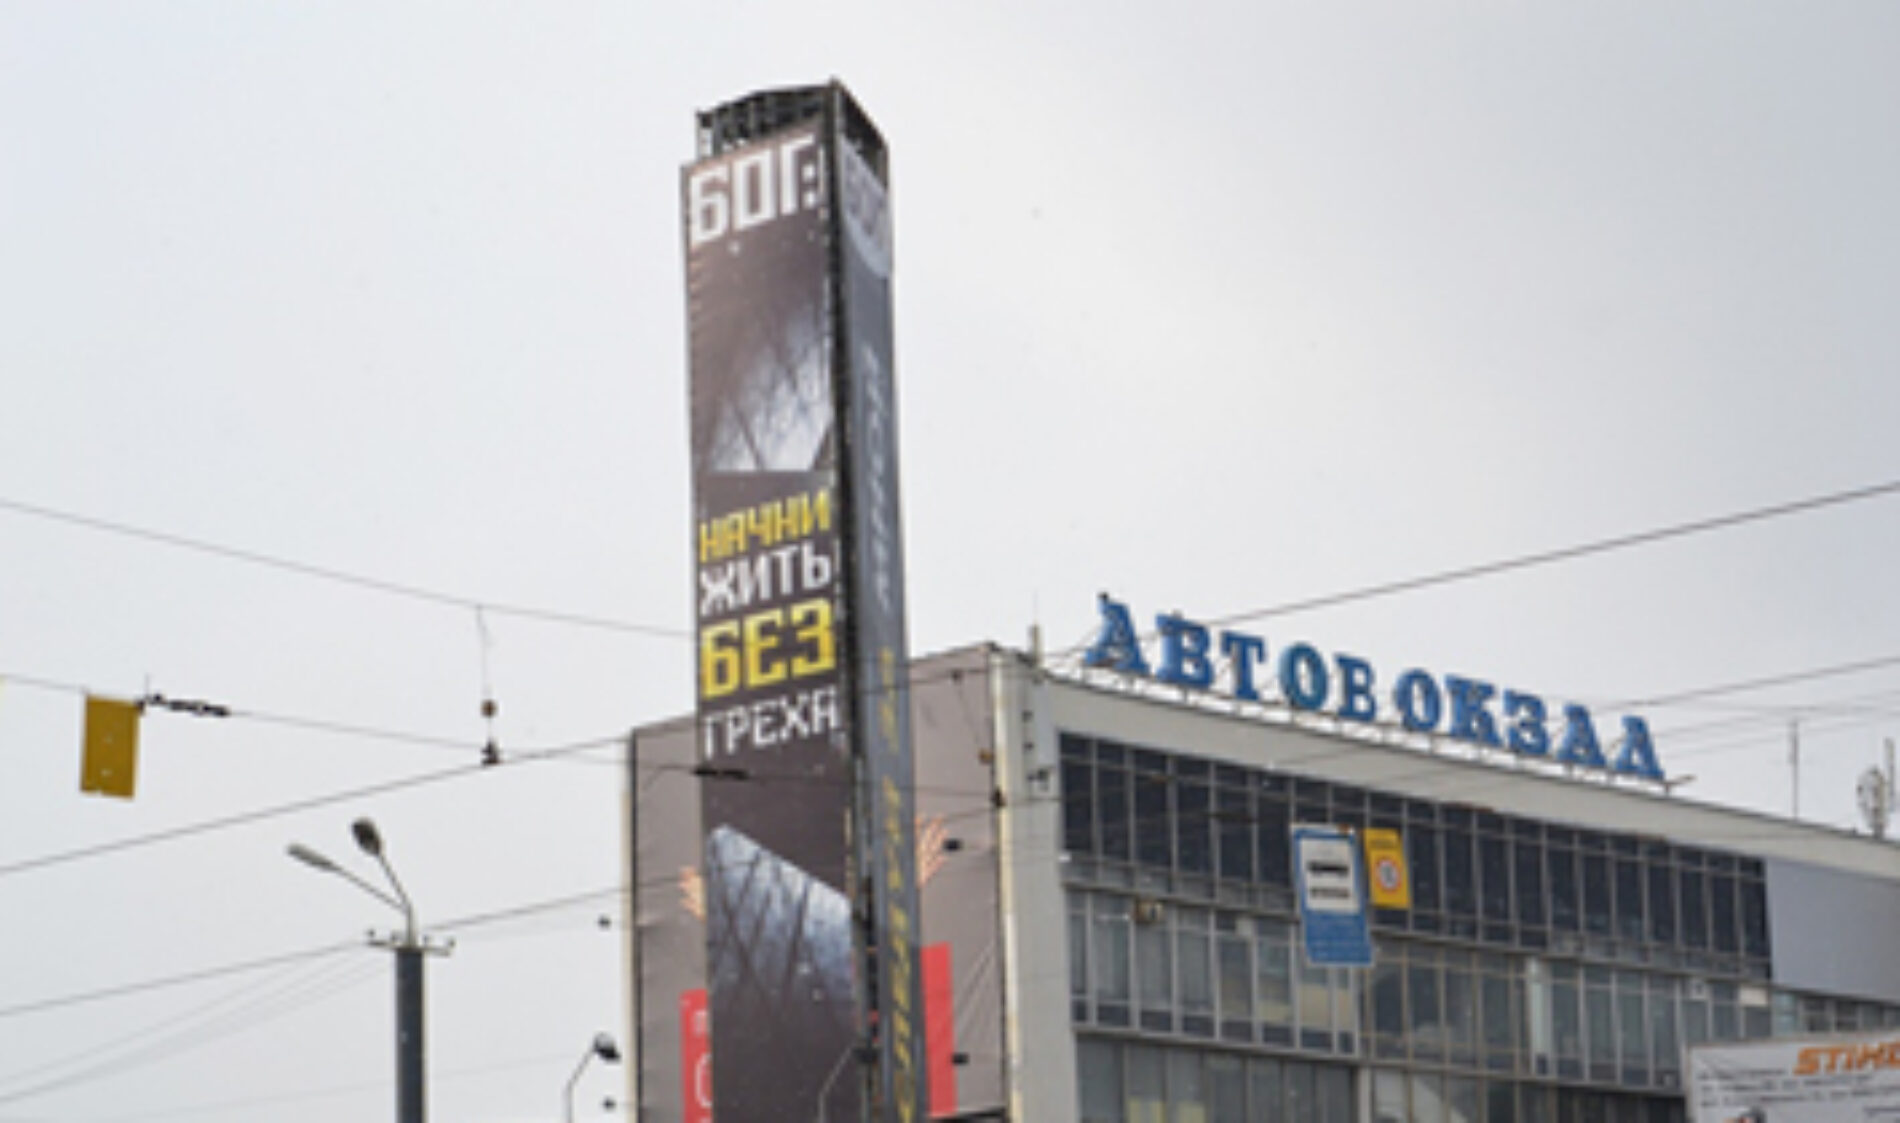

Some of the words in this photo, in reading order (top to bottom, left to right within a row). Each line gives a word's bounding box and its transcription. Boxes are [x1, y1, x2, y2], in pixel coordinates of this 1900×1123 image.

[688, 135, 816, 247] БОГ:
[700, 489, 831, 562] НАЧНИ
[699, 540, 832, 616] ЖИТЬ
[702, 598, 836, 698] БЕЗ
[1083, 597, 1665, 781] АВТОВОКЗАЛ
[704, 686, 838, 760] ГРЕХА
